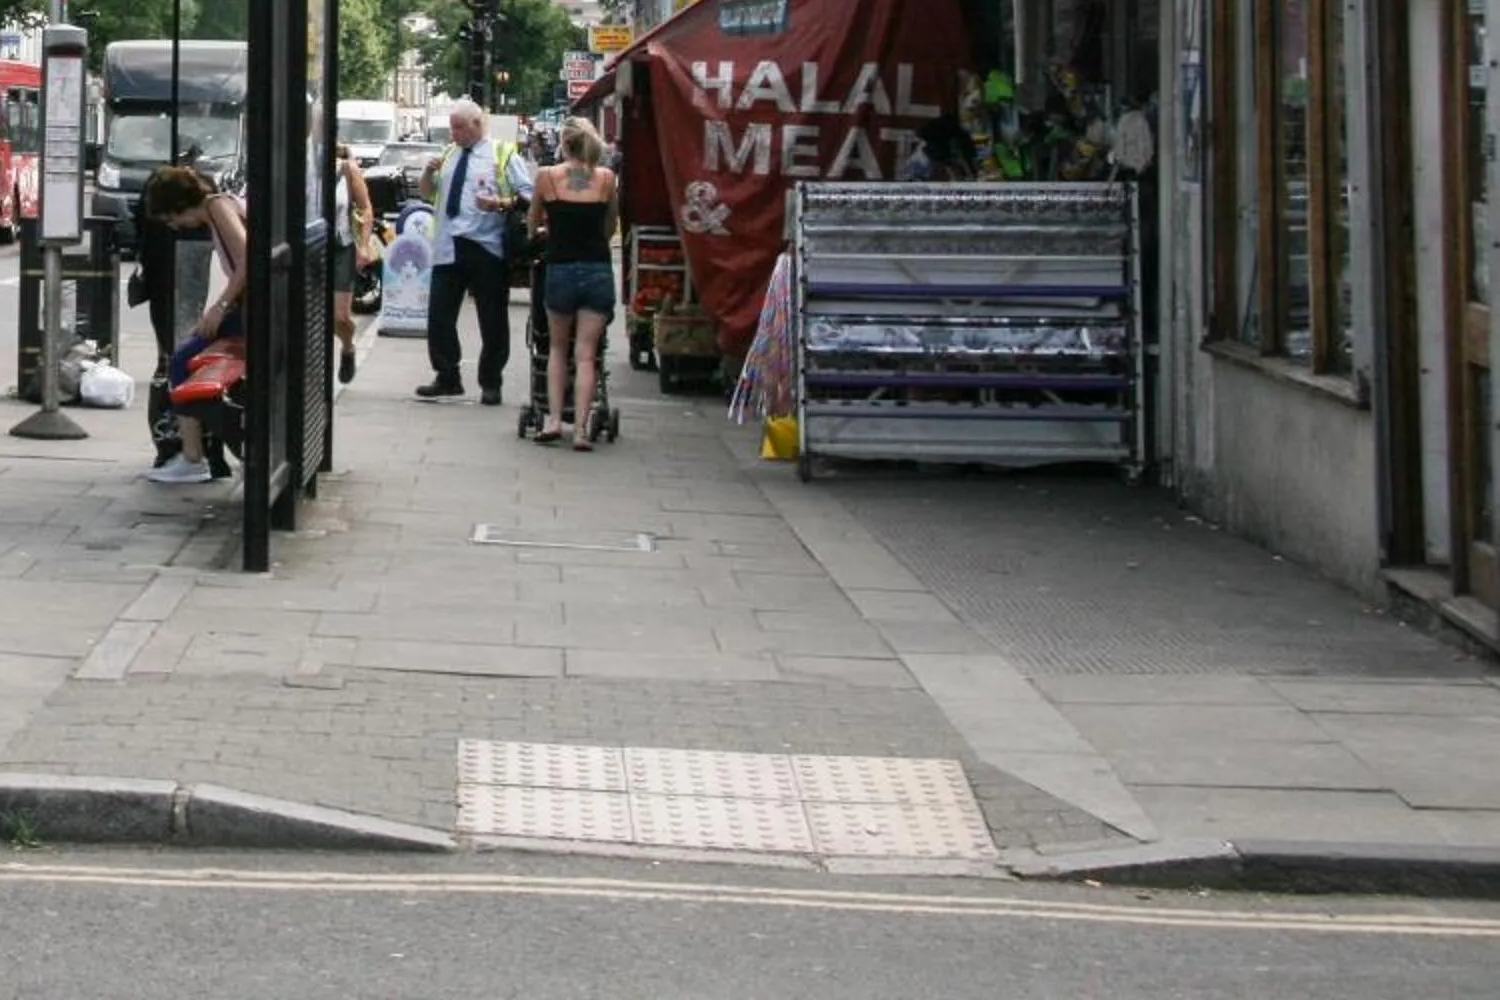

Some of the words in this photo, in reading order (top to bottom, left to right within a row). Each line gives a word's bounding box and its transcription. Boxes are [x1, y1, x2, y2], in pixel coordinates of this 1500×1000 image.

[691, 60, 941, 118] HALAL
[703, 119, 920, 181] MEAT
[682, 180, 732, 236] &
